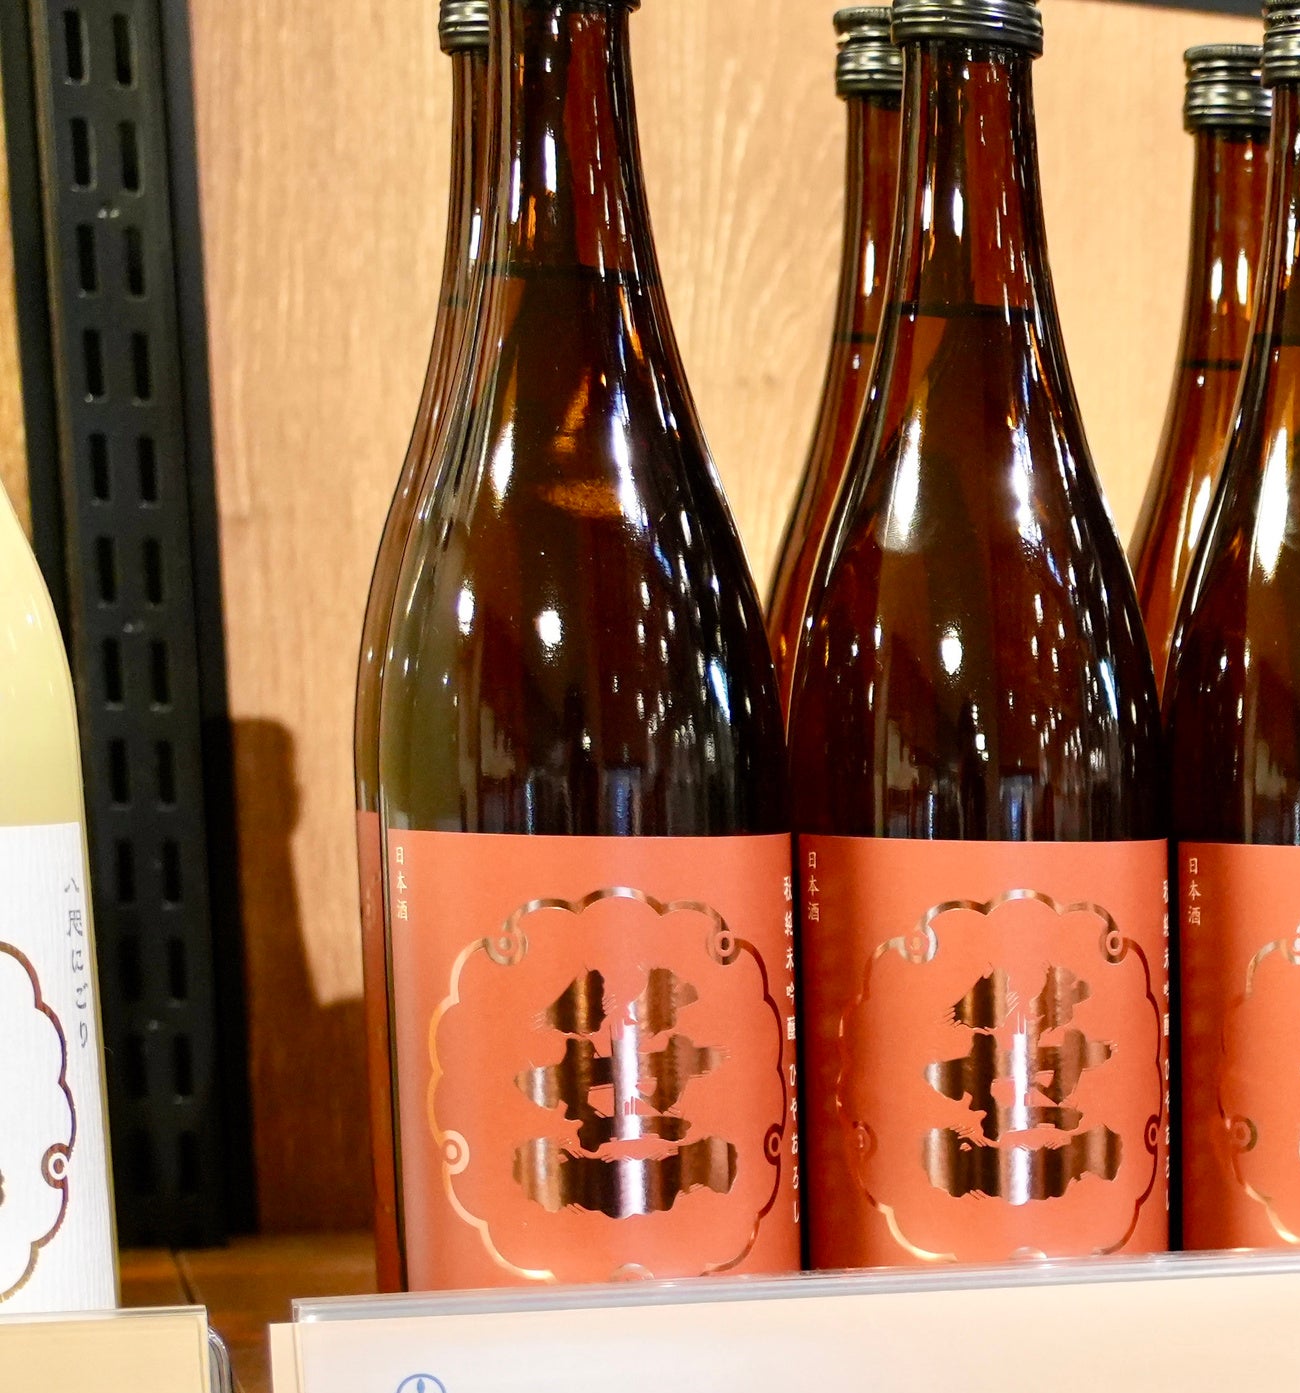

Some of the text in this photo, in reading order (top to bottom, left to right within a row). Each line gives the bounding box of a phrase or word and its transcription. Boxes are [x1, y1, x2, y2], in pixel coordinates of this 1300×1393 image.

[395, 846, 409, 922] 日本酒
[807, 851, 820, 922] 日本酒
[1187, 857, 1201, 926] 日本酒
